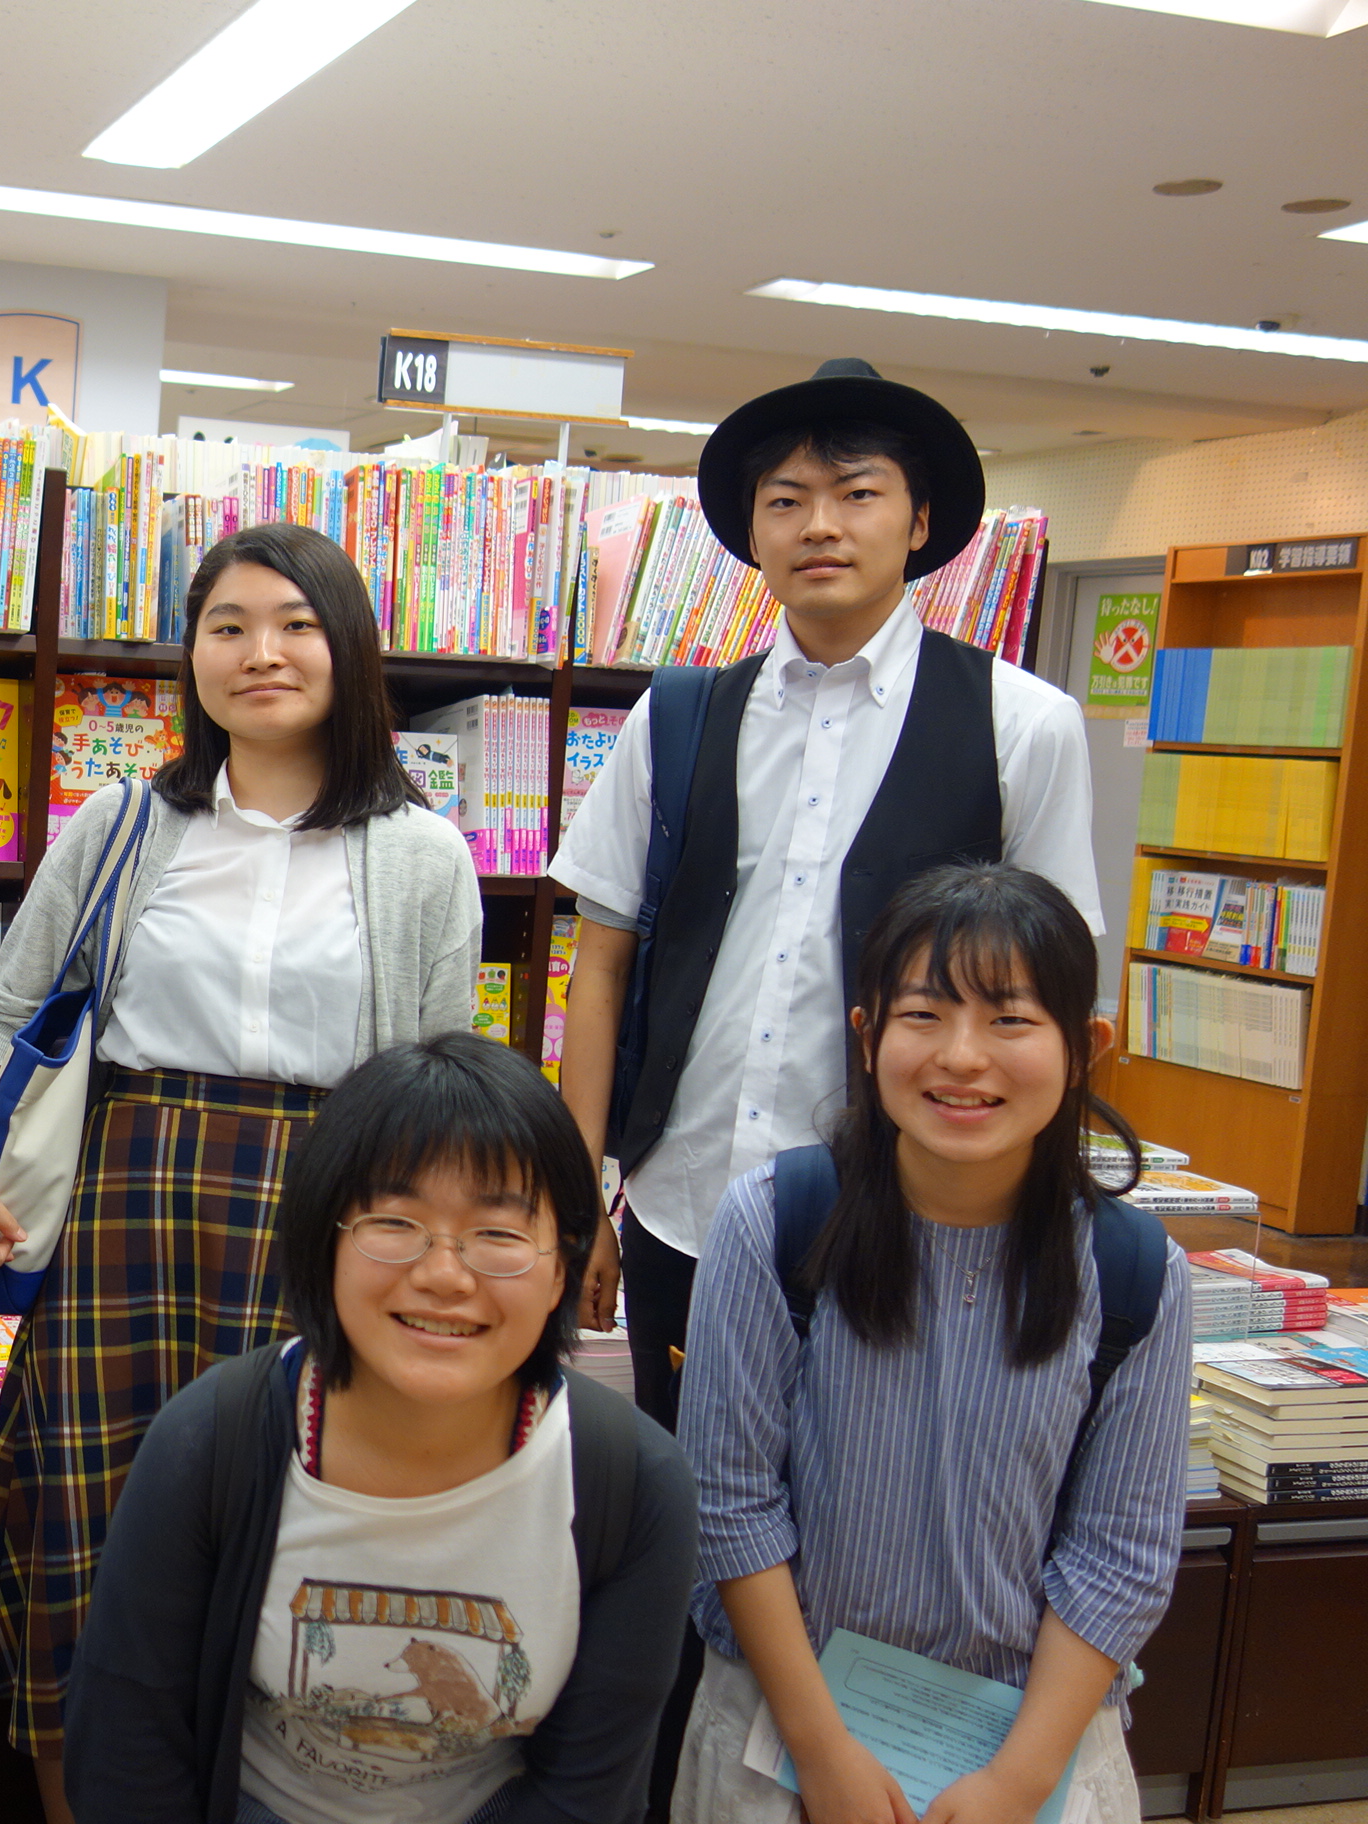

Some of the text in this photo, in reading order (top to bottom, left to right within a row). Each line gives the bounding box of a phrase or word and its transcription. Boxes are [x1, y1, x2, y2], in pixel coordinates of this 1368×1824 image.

[11, 356, 54, 407] K
[394, 350, 438, 393] K18
[1249, 543, 1352, 568] K02 学習指導要領
[1100, 597, 1158, 617] 待ったなし!
[88, 720, 144, 733] 0~5歳児の
[565, 730, 618, 750] おたより
[71, 757, 157, 780] うたあそび
[1177, 885, 1214, 899] 移行措置
